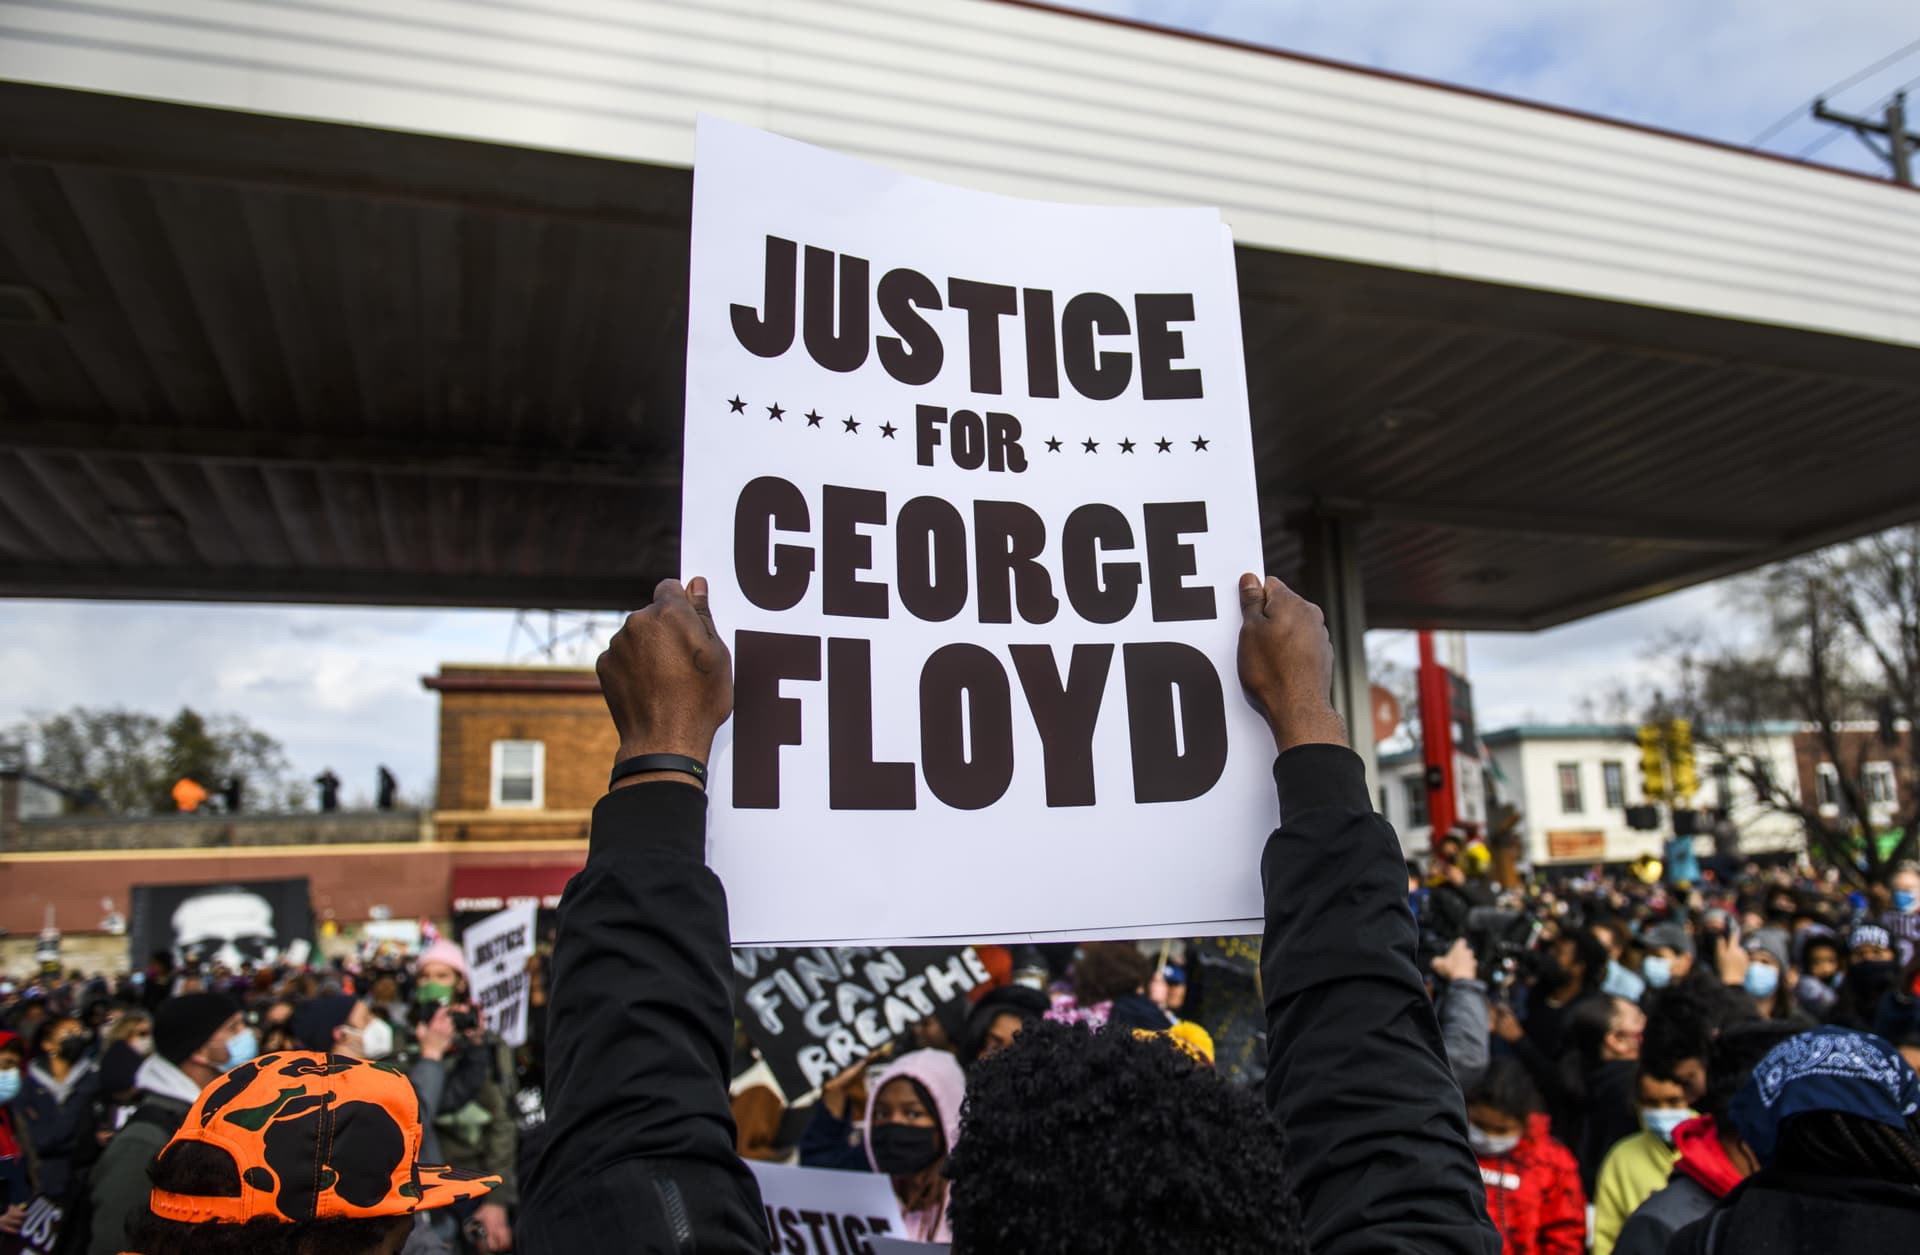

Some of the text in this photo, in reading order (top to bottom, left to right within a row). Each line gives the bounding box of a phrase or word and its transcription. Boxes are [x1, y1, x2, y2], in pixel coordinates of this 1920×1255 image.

[730, 235, 1203, 400] JUSTICE
[916, 404, 1028, 473] FOR
[734, 476, 1217, 624] GEORGE
[732, 629, 1228, 810] FLOYD
[745, 946, 875, 1035] FINA
[803, 951, 906, 1038] CAN
